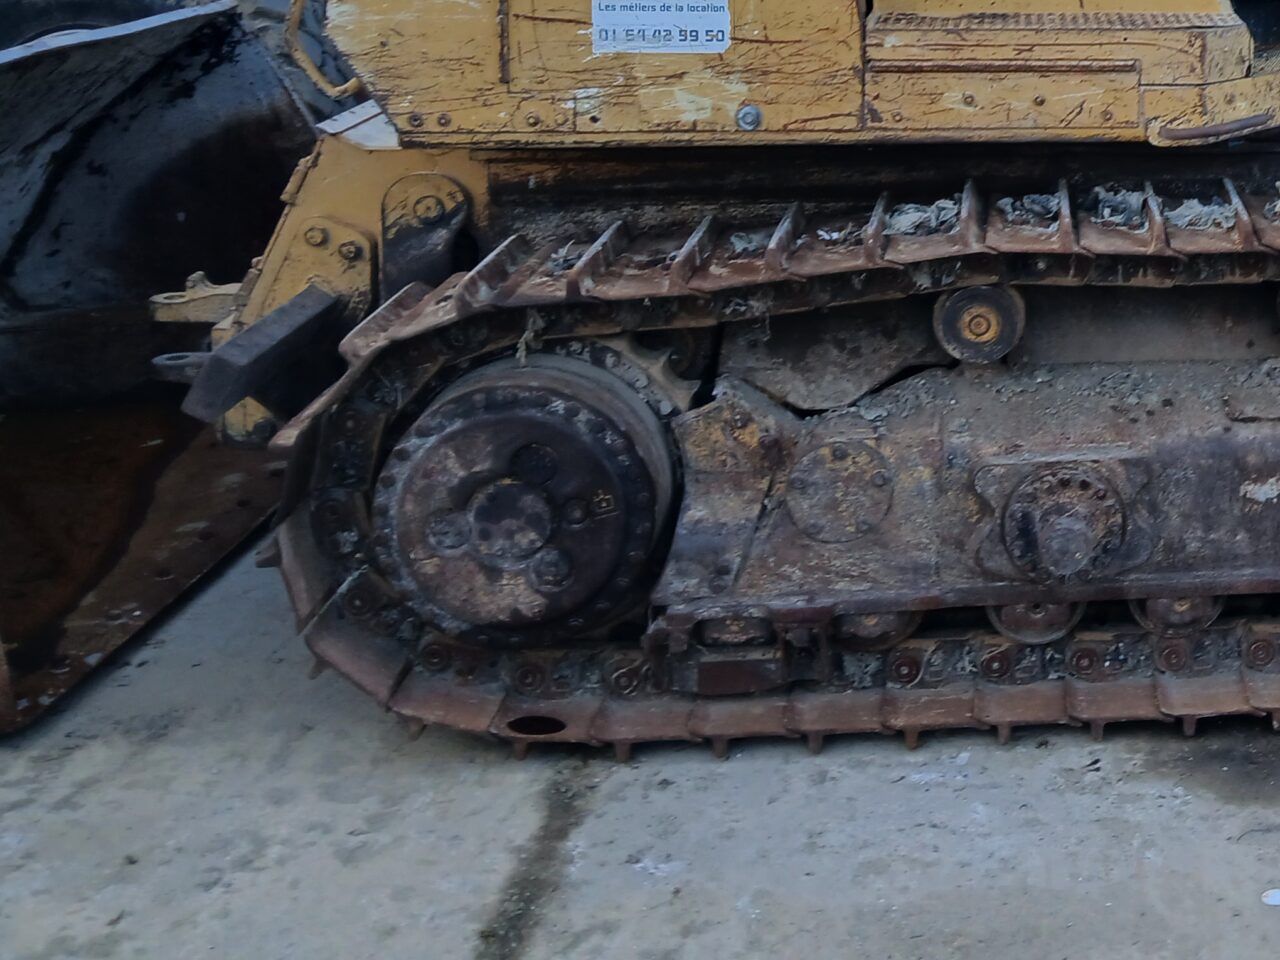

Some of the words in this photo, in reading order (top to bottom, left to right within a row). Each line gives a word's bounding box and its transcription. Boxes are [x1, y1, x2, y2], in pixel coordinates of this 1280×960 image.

[598, 1, 616, 12] Les
[620, 2, 656, 12] métiers
[660, 3, 672, 12] de
[675, 3, 684, 12] la
[687, 3, 725, 13] location
[599, 28, 616, 42] 01
[705, 29, 725, 42] 50
